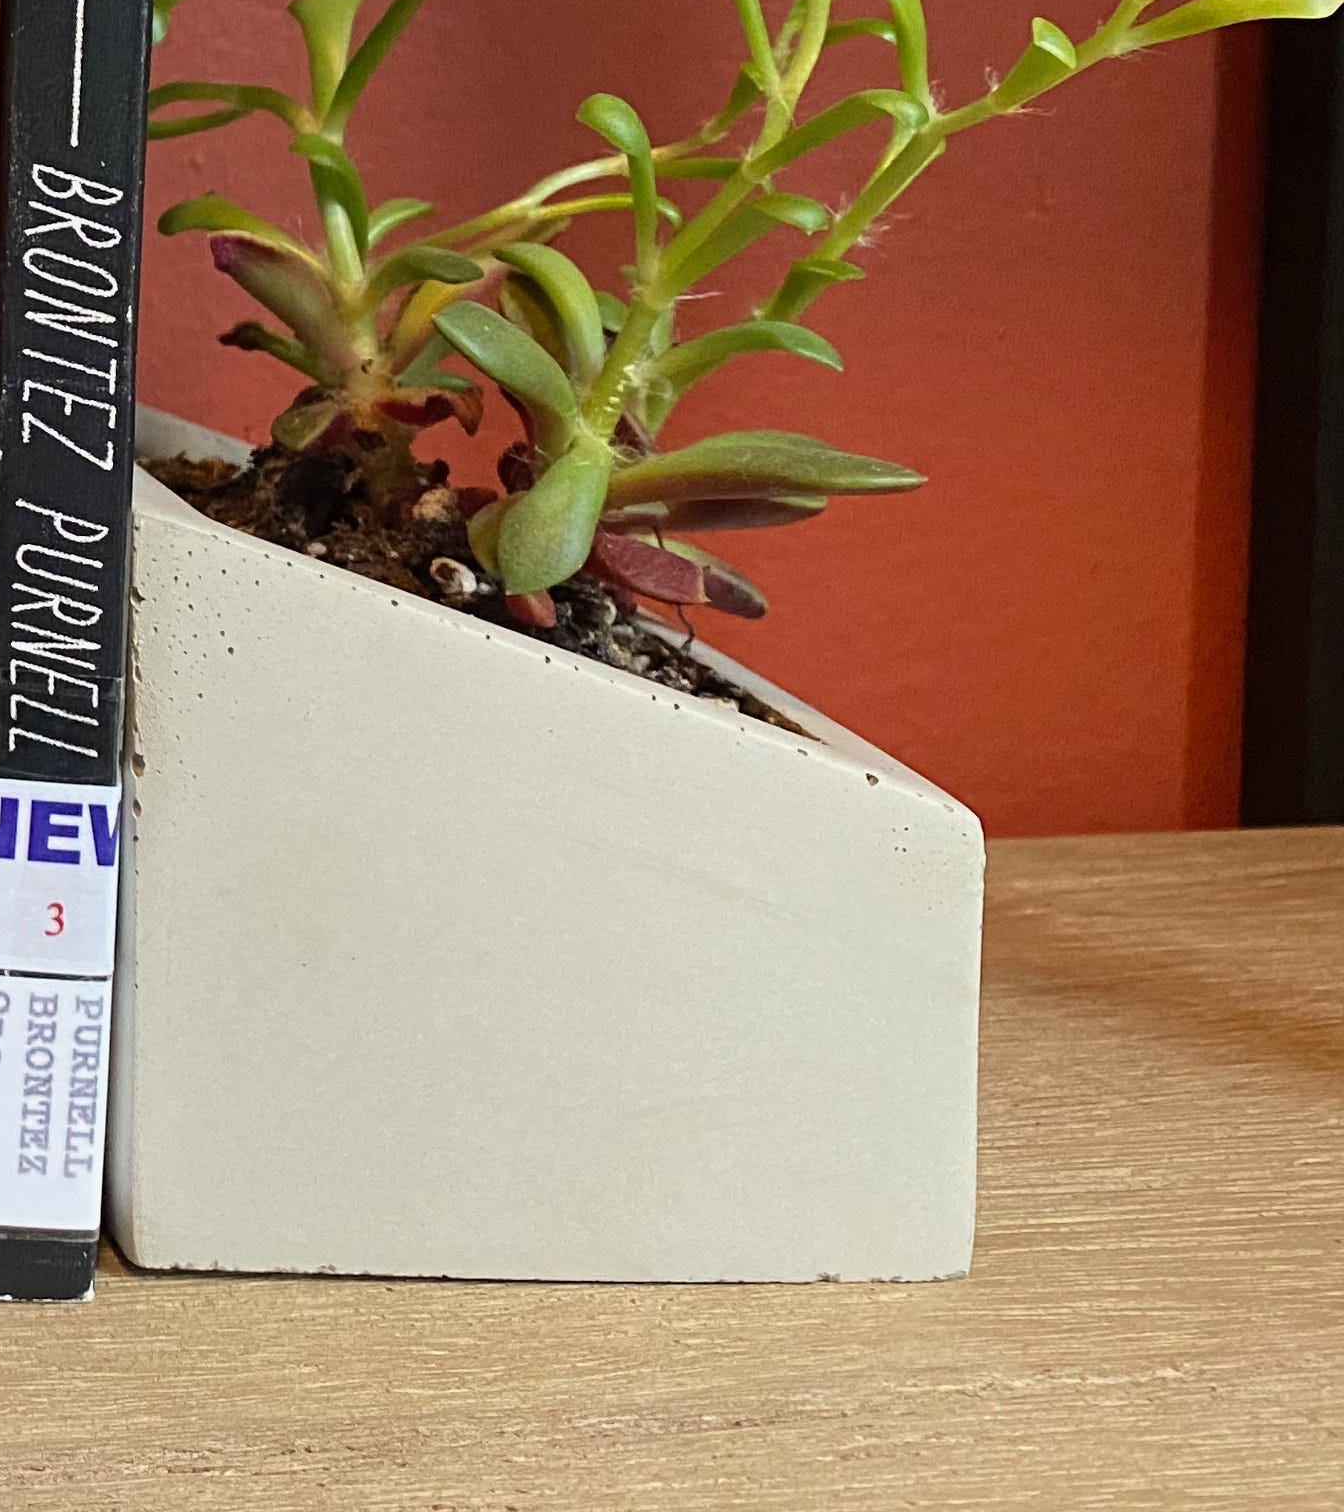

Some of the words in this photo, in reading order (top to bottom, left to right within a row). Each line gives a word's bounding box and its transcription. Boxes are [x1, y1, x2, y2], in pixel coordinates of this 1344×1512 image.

[20, 161, 123, 472] BRONTEZ
[8, 497, 109, 759] PURNELL
[44, 902, 66, 936] 3
[17, 992, 60, 1177] BRONTEZ
[63, 995, 104, 1179] PURNELL
